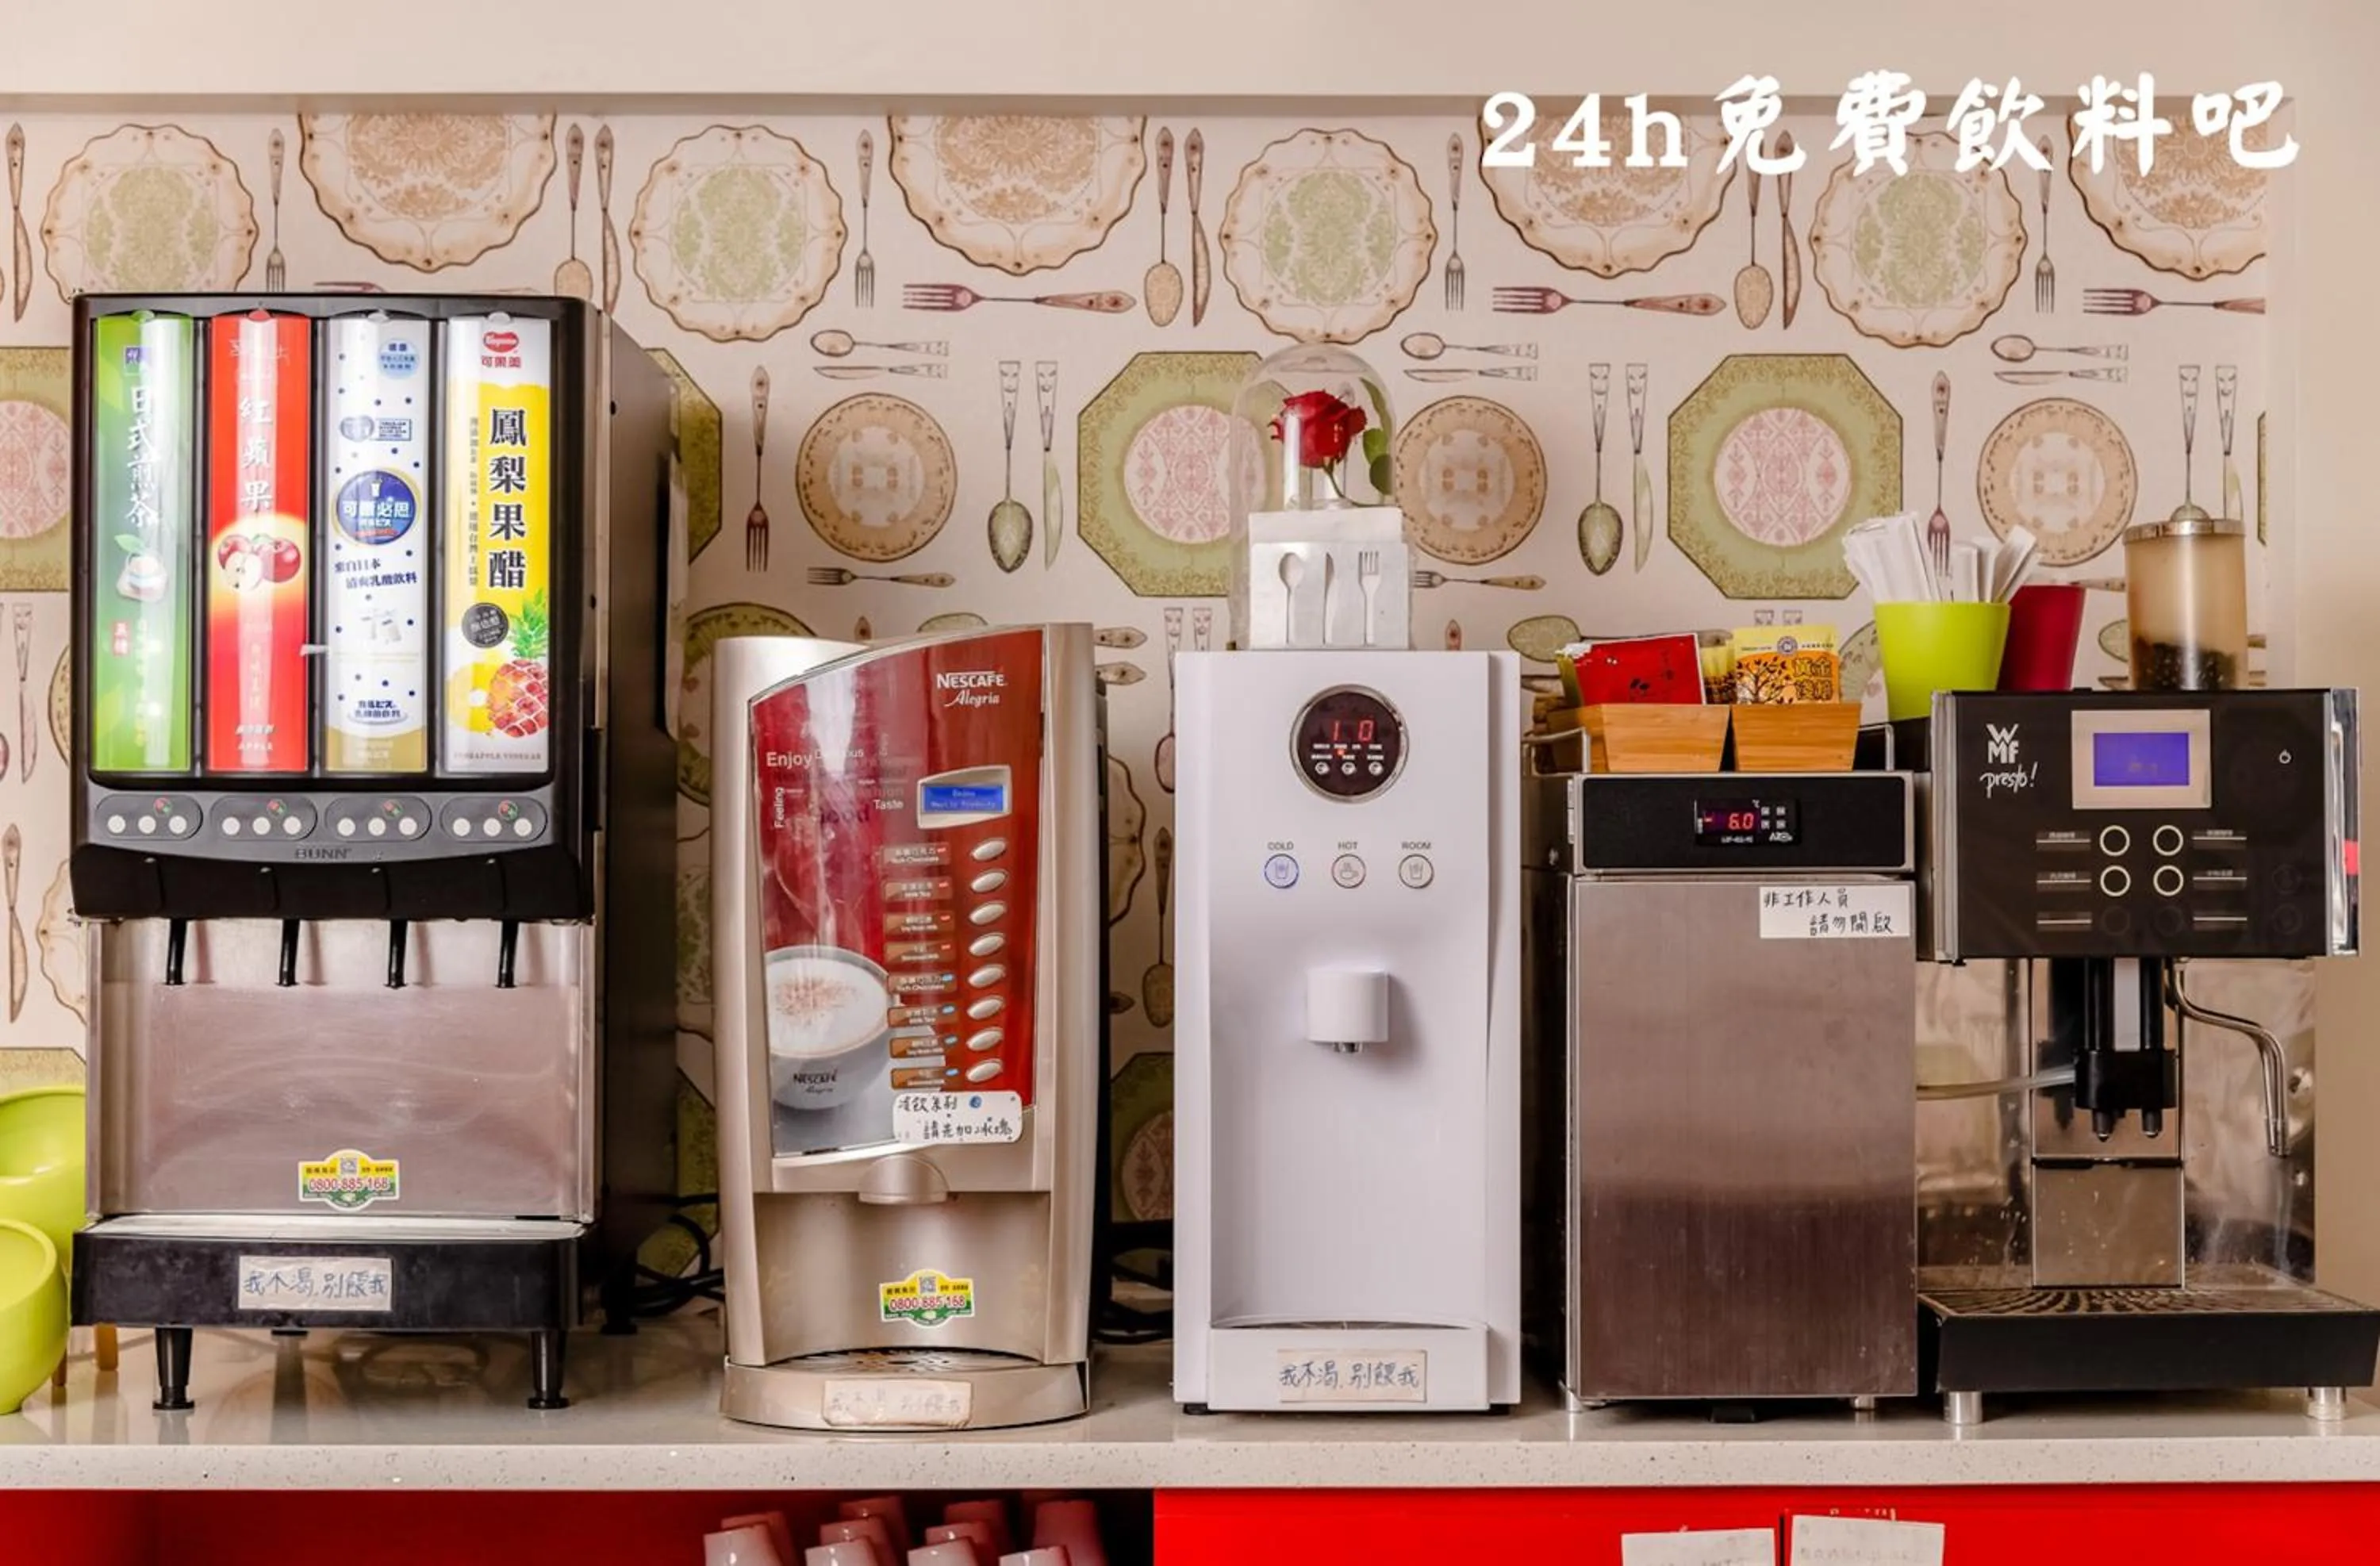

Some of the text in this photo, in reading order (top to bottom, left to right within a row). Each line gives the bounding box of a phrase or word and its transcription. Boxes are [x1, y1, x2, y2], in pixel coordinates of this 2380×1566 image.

[482, 355, 521, 369] 可果美
[240, 397, 273, 514] 紅蘋果
[489, 408, 527, 589] 鳳梨果醋
[944, 689, 1000, 709] Alegria
[1986, 723, 2020, 765] WMF
[766, 751, 812, 770] Enjoy
[1979, 762, 2039, 799] presto!
[774, 787, 785, 829] Feeling
[873, 800, 904, 811] Taste
[295, 847, 351, 860] BUNN
[1267, 842, 1295, 851] COLD
[1338, 842, 1358, 850] HOT
[1401, 842, 1432, 850] ROOM
[1764, 888, 1848, 908] 非工作人員
